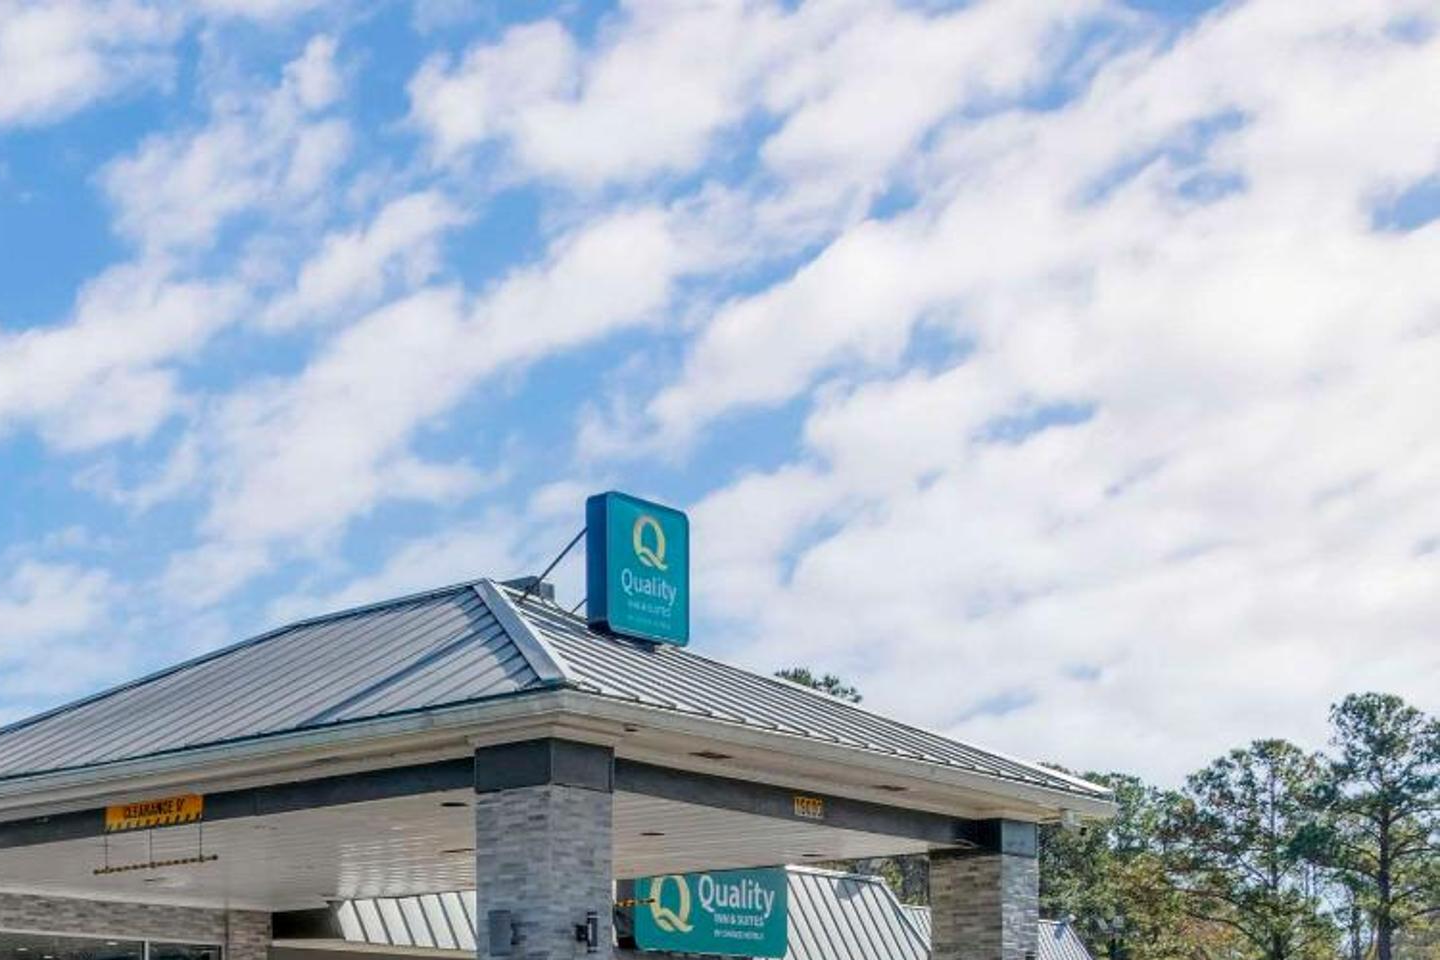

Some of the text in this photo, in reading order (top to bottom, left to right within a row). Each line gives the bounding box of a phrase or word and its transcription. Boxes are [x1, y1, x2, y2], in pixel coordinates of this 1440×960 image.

[633, 515, 668, 570] Q
[621, 568, 677, 605] Quality
[124, 799, 173, 818] CLEARANCE
[650, 874, 695, 933] Q
[698, 874, 775, 919] Quality
